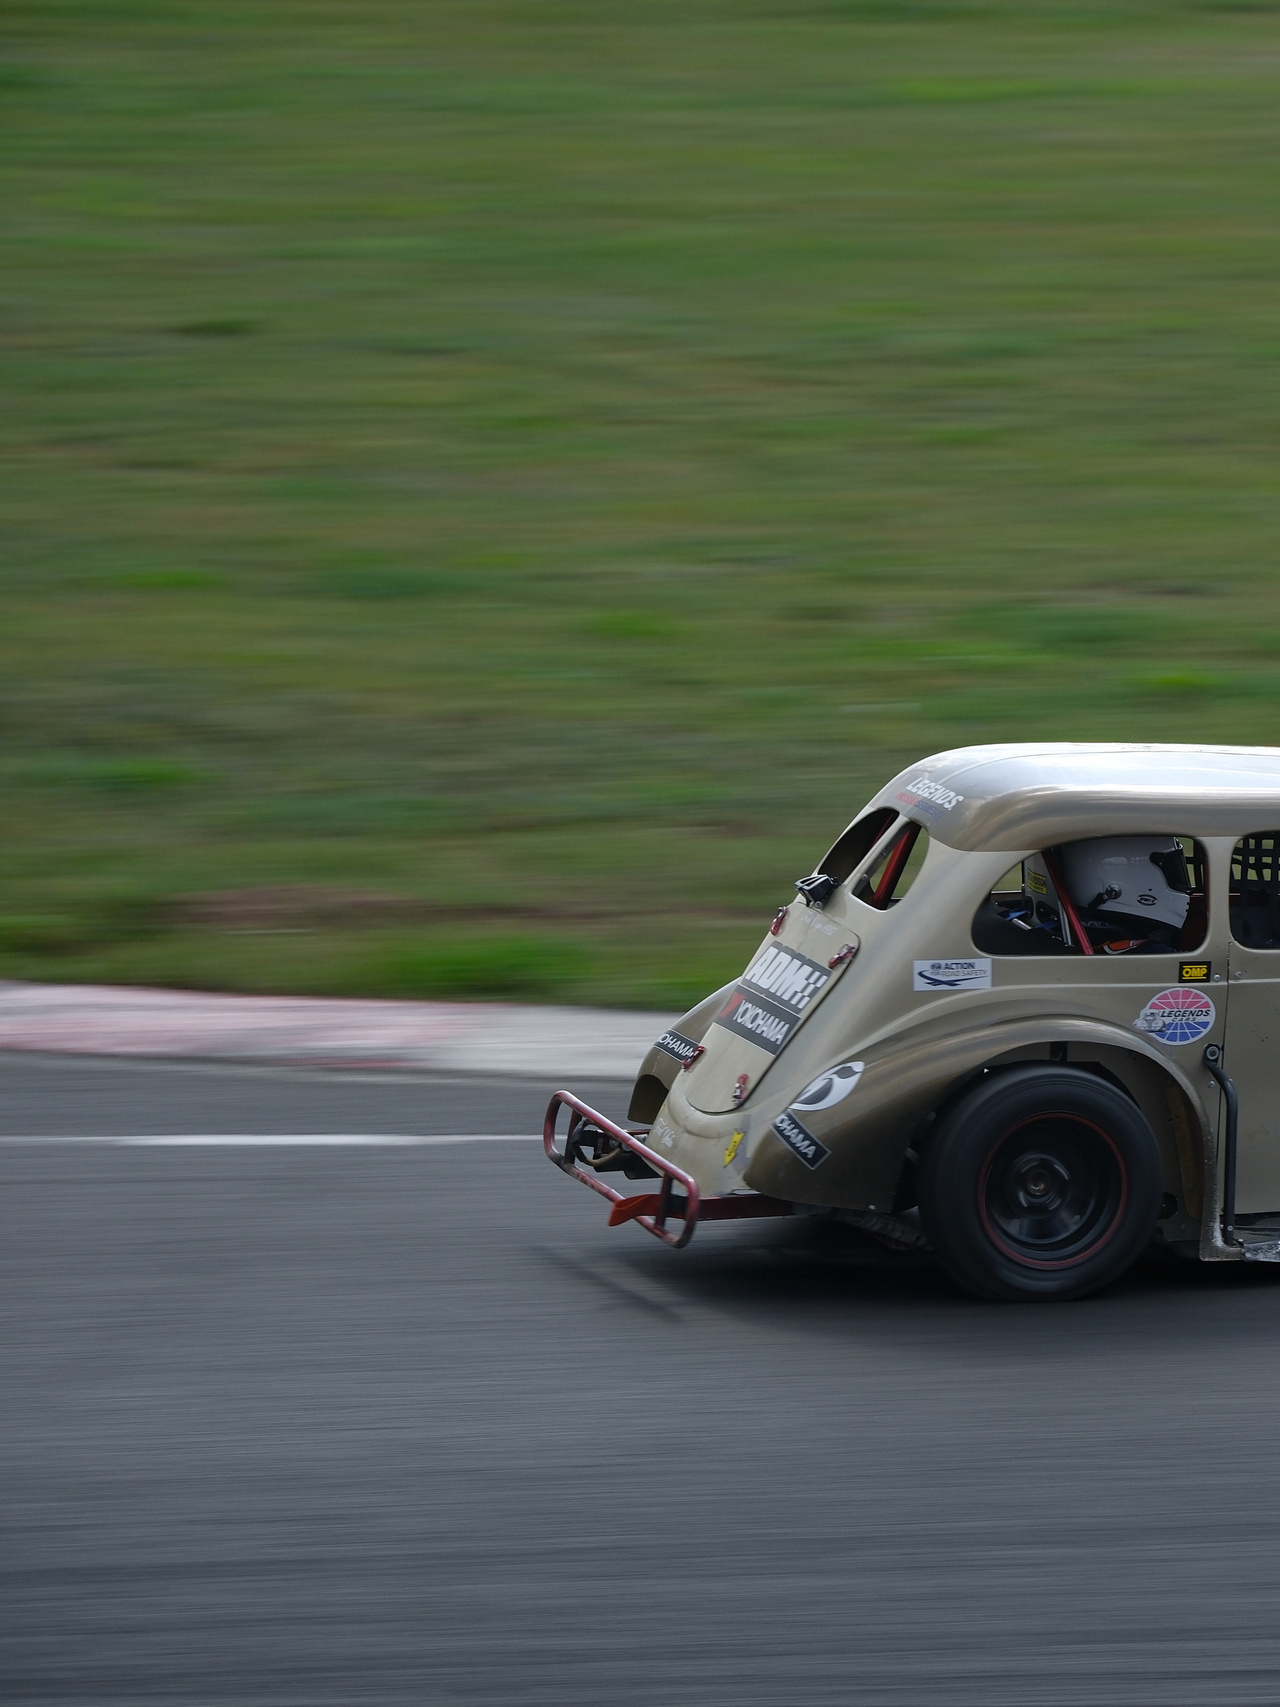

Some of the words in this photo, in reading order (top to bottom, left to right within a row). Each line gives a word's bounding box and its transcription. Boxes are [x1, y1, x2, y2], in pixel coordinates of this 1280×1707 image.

[944, 962, 975, 970] ACTION
[1182, 968, 1208, 977] OMP
[1161, 1009, 1211, 1018] LEGENDS
[733, 1000, 790, 1045] YOKOHAMA
